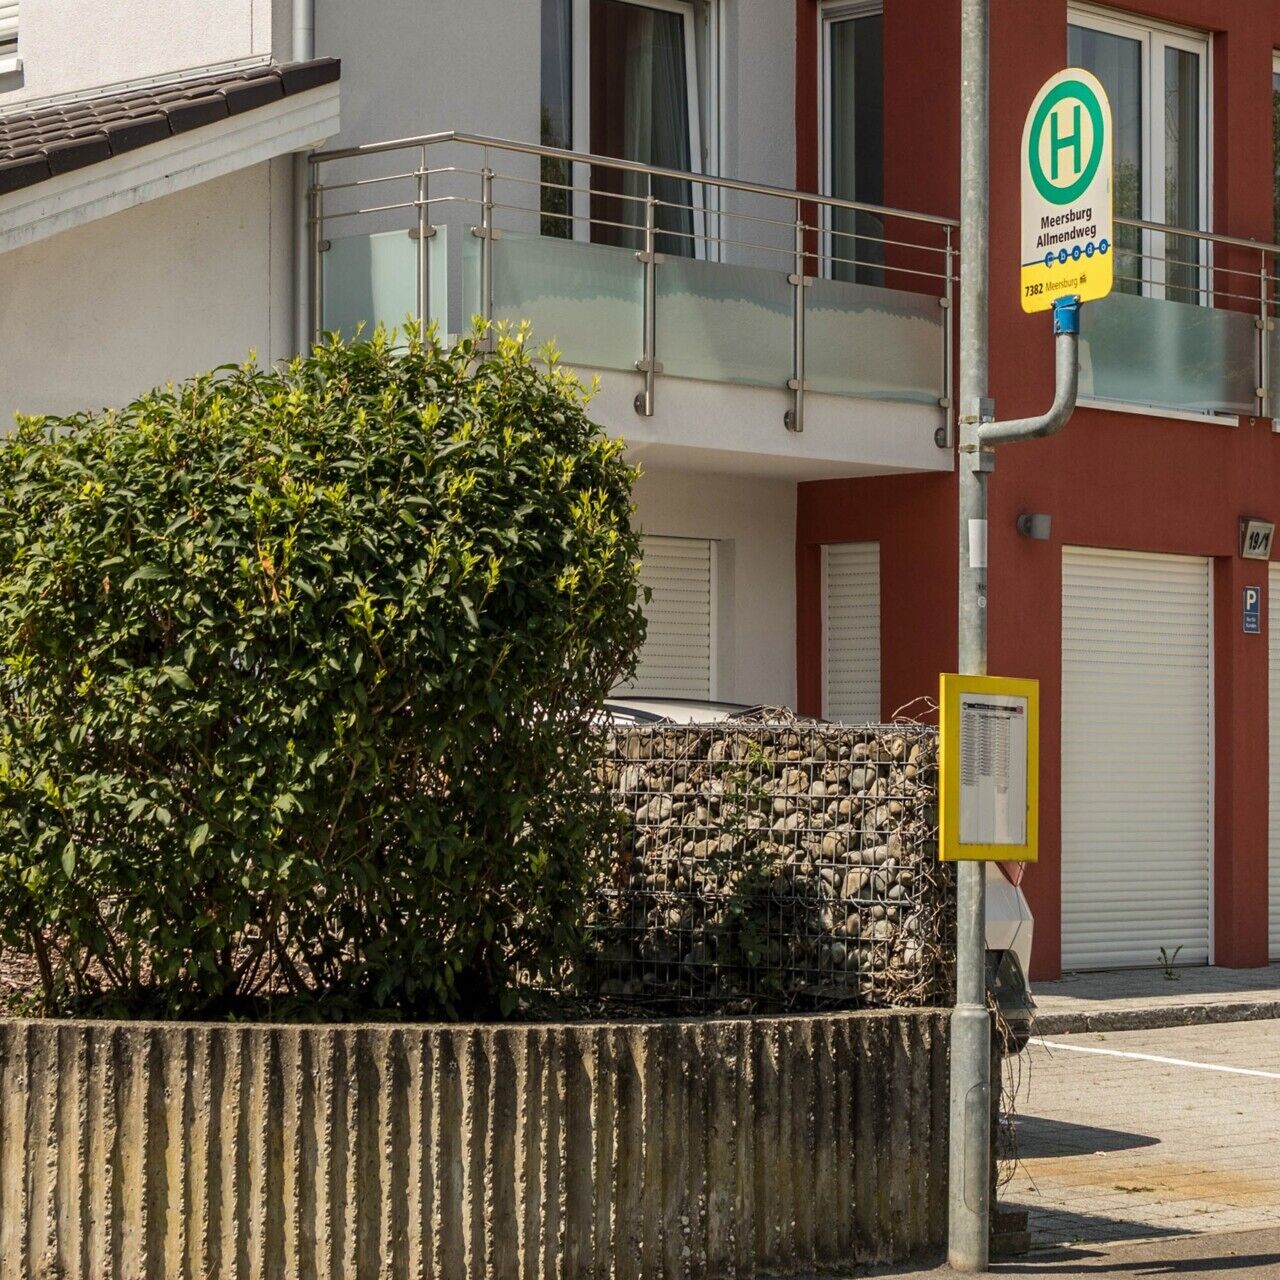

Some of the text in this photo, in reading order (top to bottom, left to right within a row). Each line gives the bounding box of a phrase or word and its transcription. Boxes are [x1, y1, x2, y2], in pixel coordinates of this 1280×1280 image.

[1051, 105, 1081, 180] H
[1041, 208, 1092, 229] Meersburg
[1036, 225, 1096, 248] Allmendweg
[1025, 278, 1078, 297] 7382 Meersburg
[1249, 532, 1270, 550] 19/1
[1247, 590, 1257, 610] P
